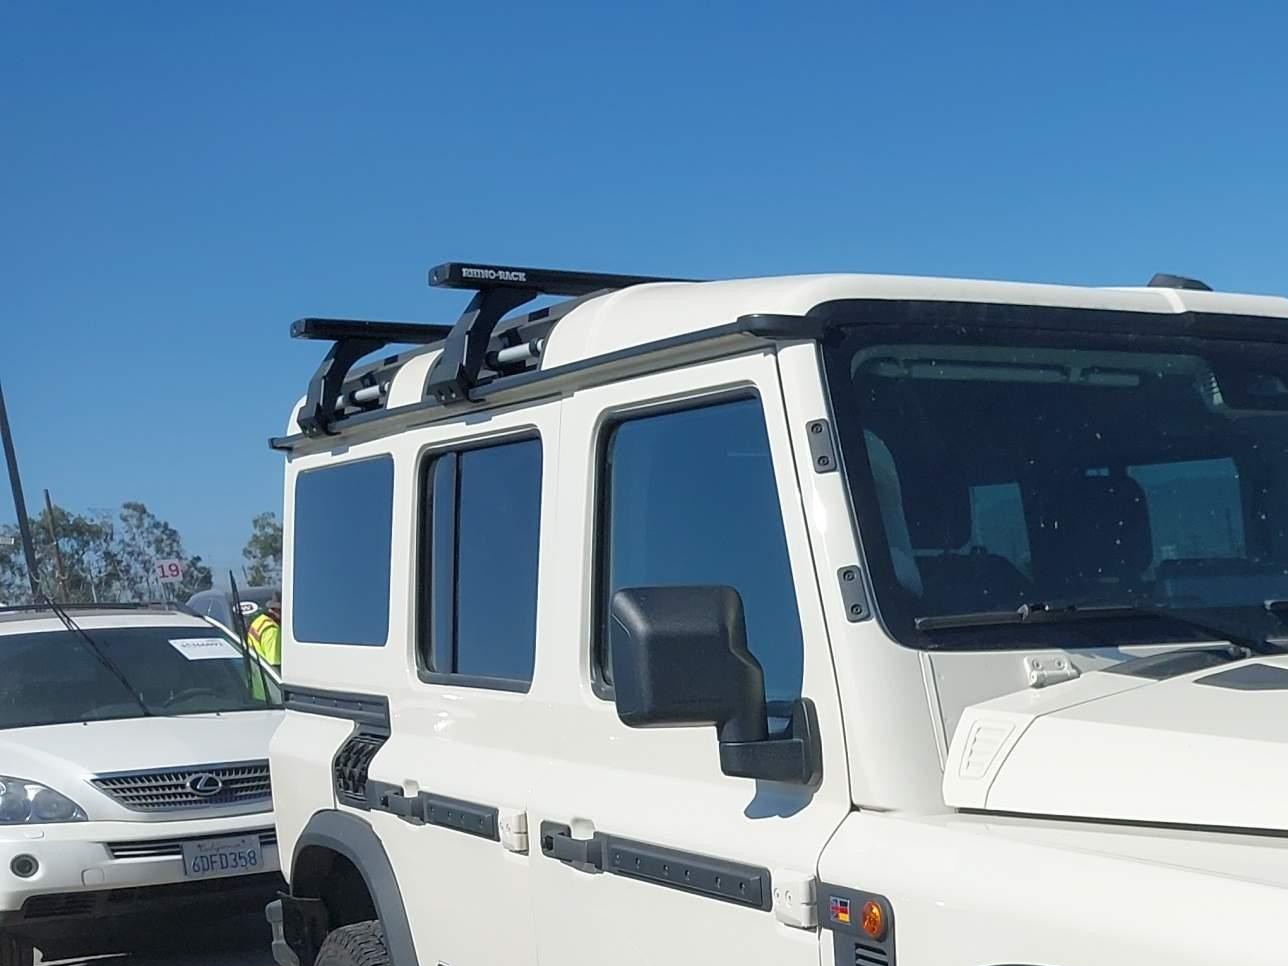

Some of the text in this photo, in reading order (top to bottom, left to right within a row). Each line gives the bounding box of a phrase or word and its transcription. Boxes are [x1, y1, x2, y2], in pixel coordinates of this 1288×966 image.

[461, 267, 527, 282] RHINO-RACK
[158, 563, 180, 579] 19
[191, 849, 258, 873] 6DFD358
